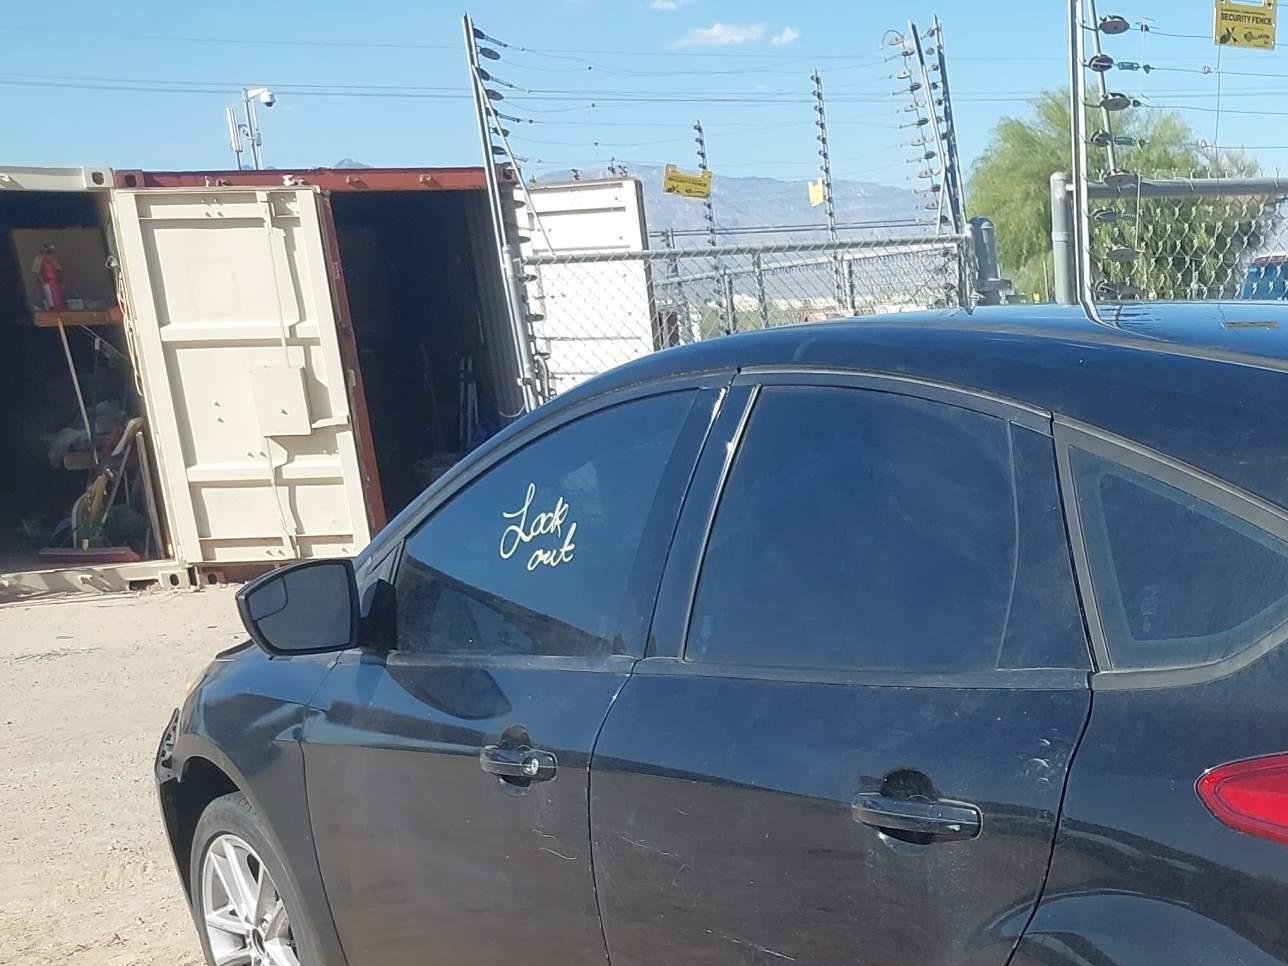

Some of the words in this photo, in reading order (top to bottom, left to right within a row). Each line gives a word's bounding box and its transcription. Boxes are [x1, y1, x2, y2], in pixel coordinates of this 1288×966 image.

[1221, 12, 1250, 23] SECURITY
[1252, 16, 1272, 25] FENCE
[527, 522, 577, 571] out
